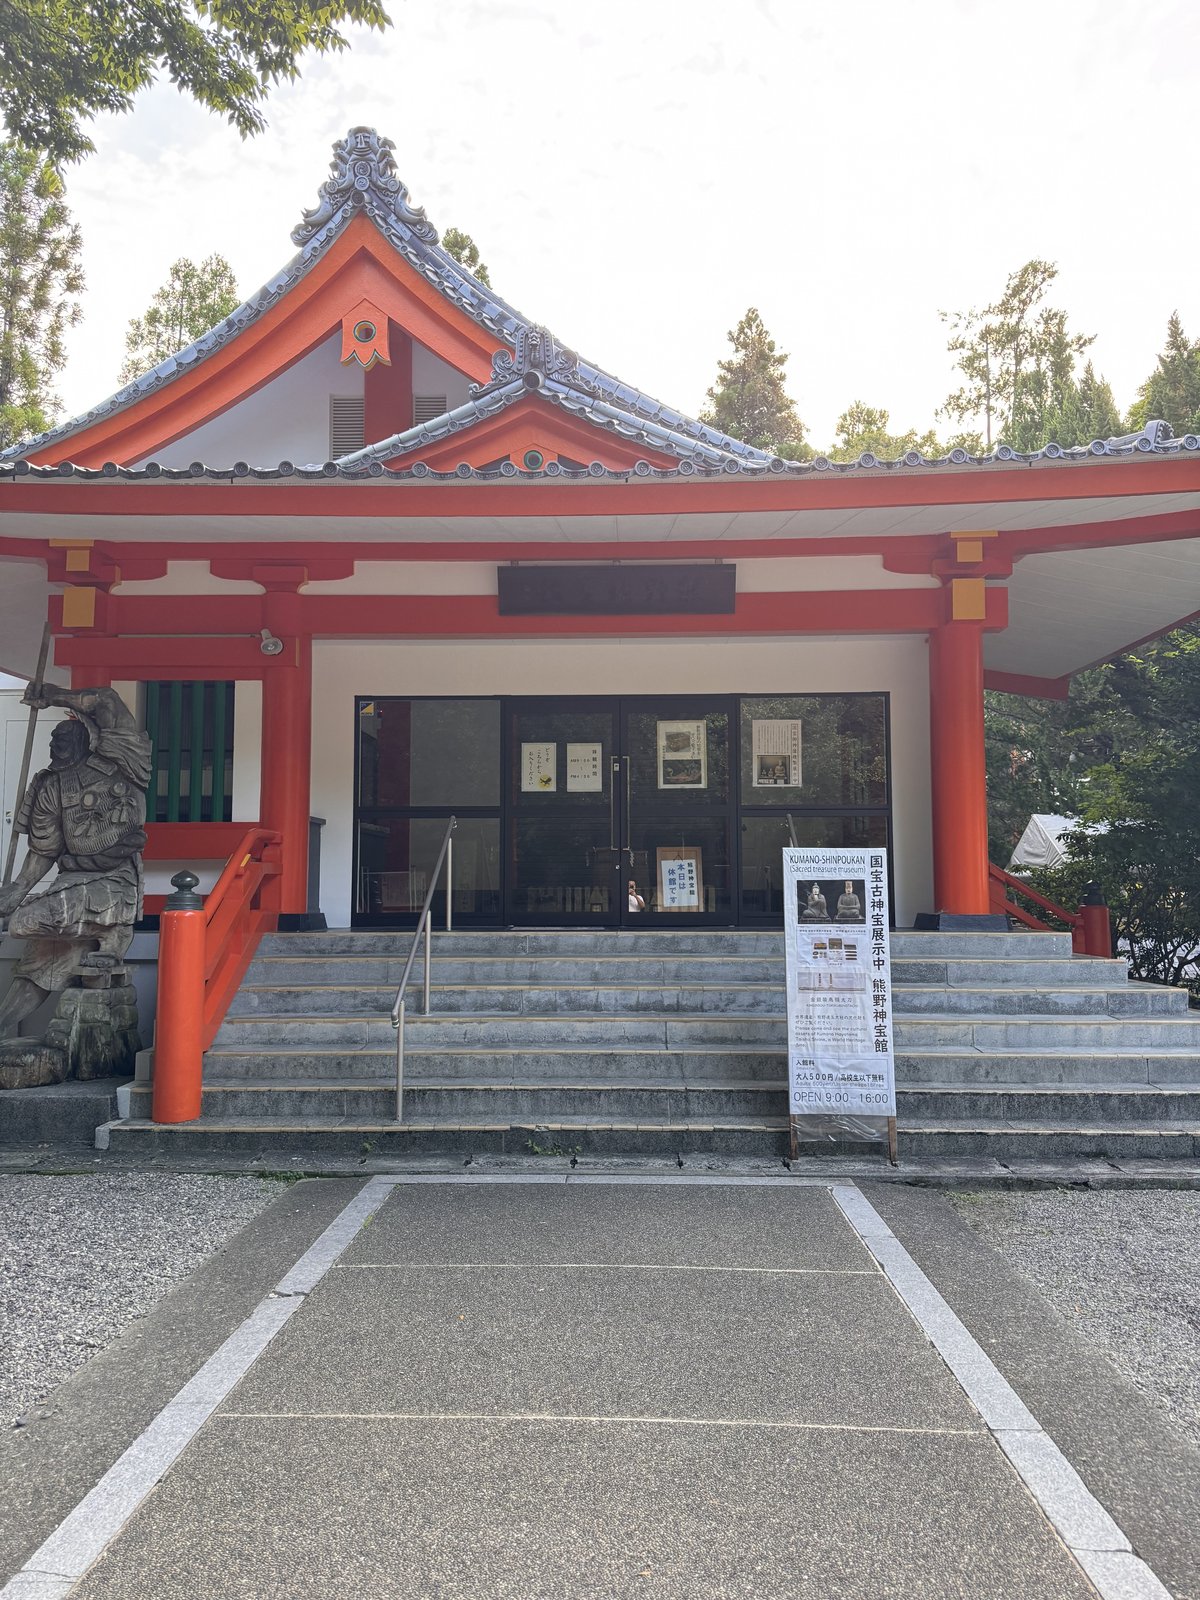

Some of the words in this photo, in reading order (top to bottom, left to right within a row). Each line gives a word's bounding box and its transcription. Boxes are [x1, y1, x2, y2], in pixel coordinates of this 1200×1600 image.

[790, 855, 865, 864] KUMANO-SHINPOUKAN
[678, 863, 686, 890] 本日は
[790, 865, 812, 873] (Sacred
[668, 868, 677, 904] 休館です
[872, 978, 888, 1053] 熊野神宝館
[793, 1092, 822, 1102] OPEN
